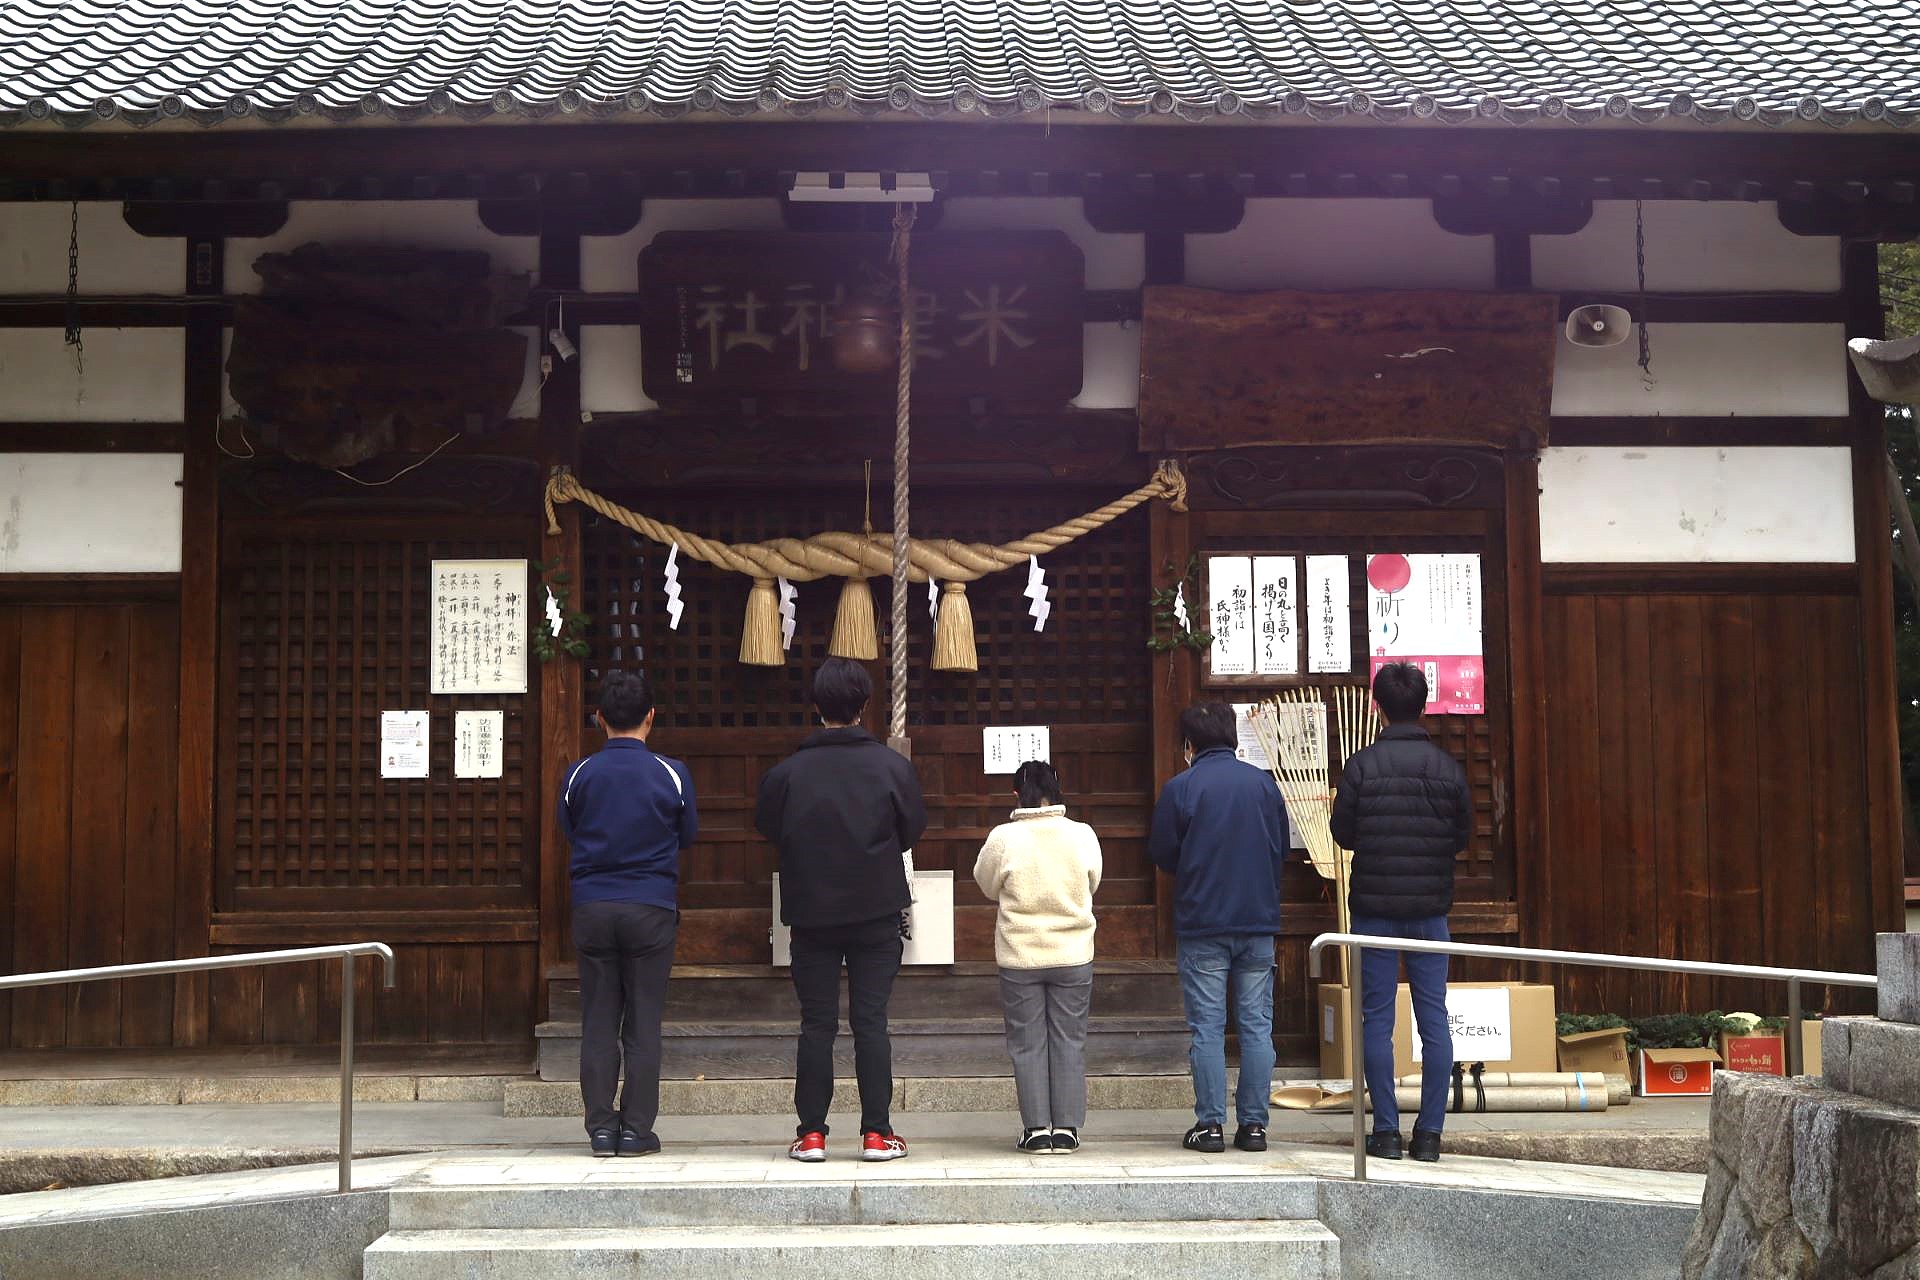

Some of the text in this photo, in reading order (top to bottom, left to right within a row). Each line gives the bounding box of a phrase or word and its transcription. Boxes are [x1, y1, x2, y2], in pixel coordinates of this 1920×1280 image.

[1449, 1025, 1502, 1037] ちください。
